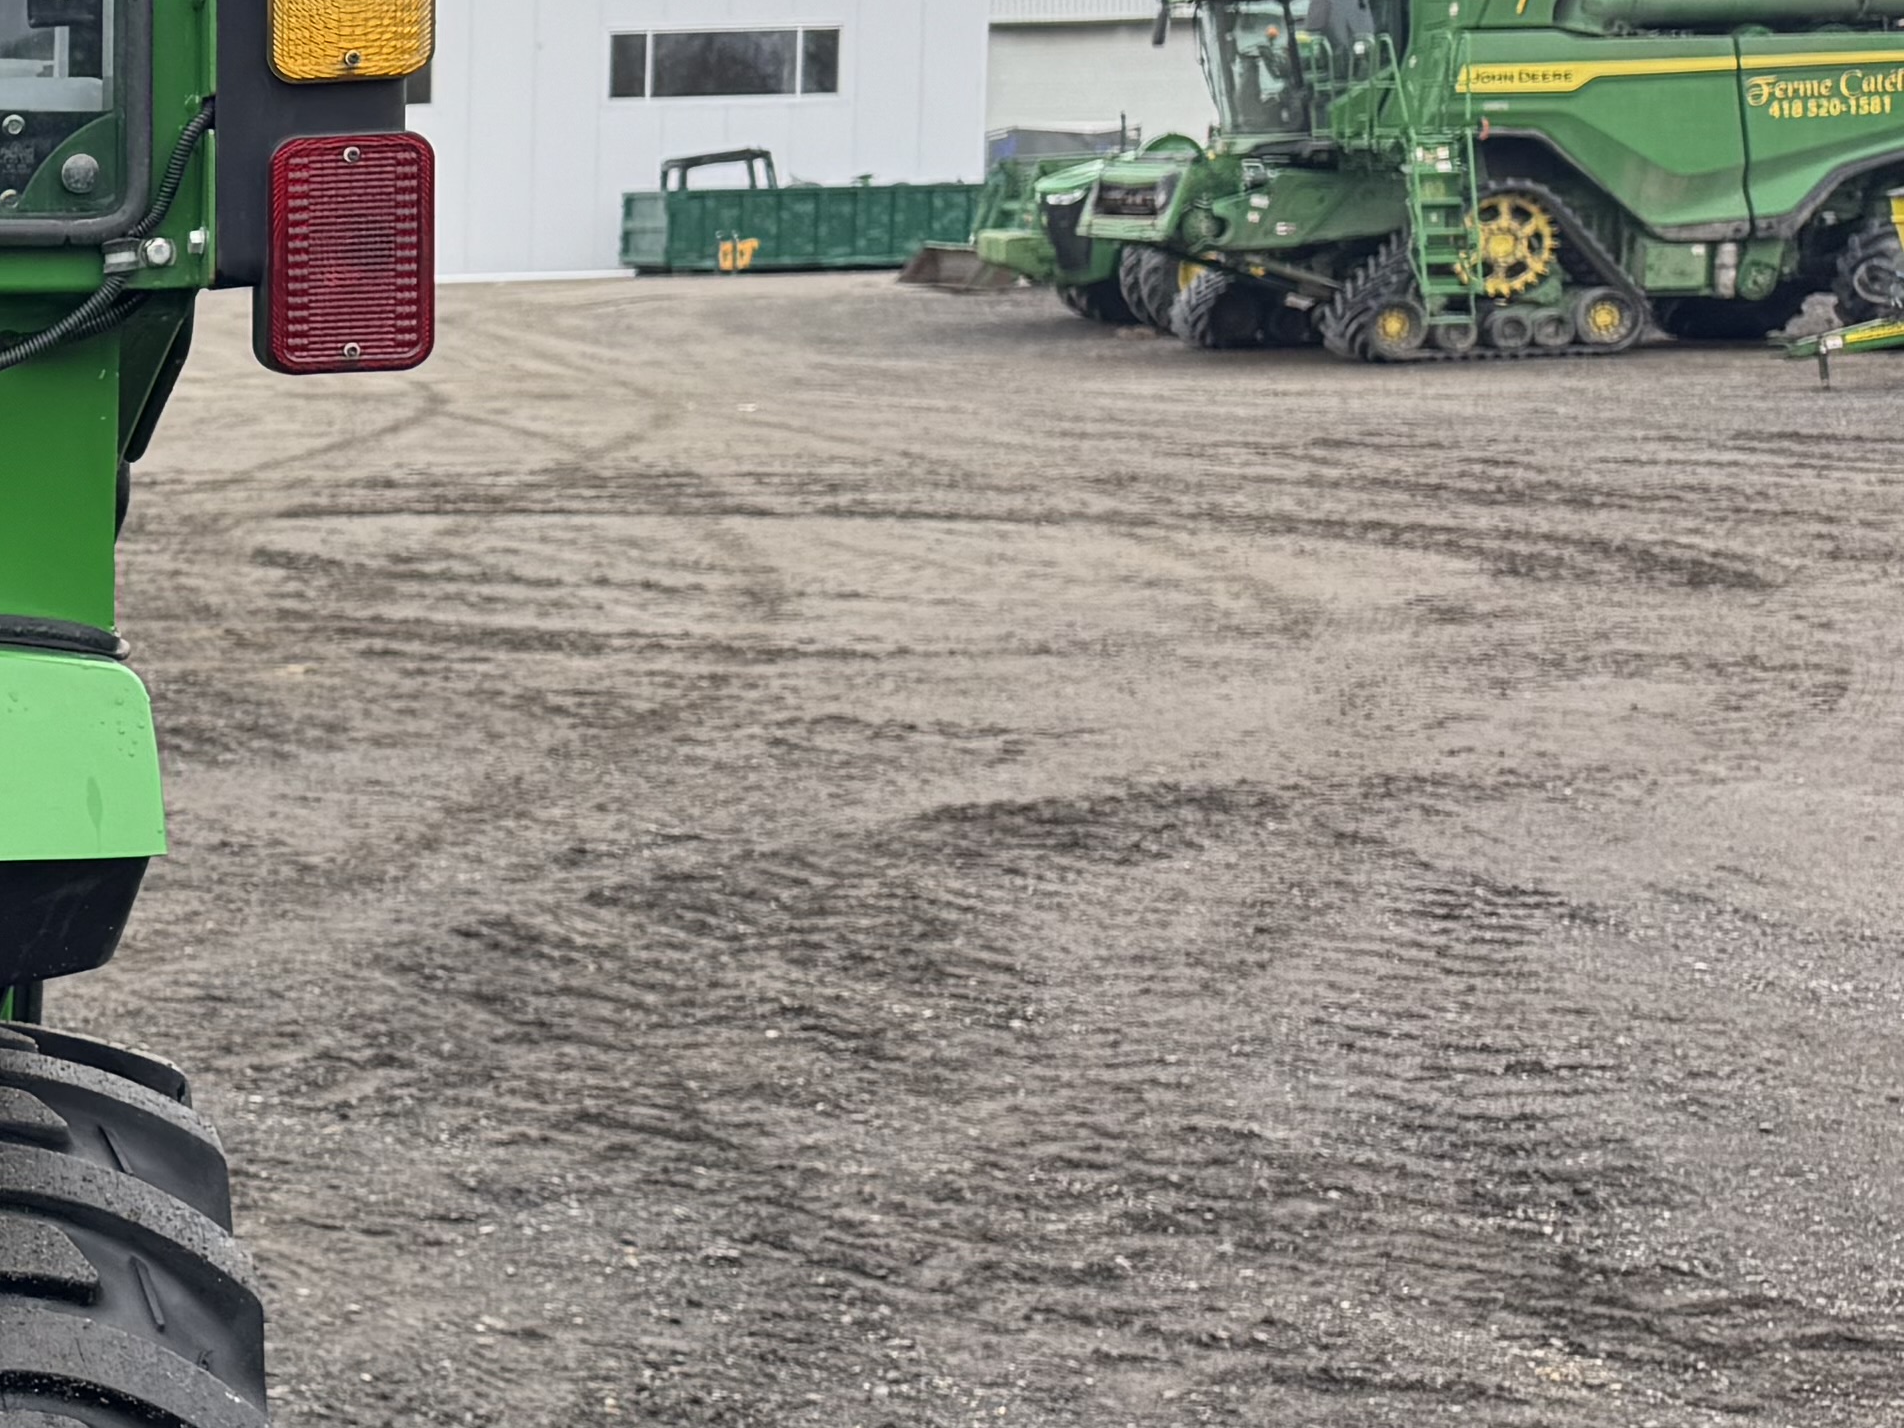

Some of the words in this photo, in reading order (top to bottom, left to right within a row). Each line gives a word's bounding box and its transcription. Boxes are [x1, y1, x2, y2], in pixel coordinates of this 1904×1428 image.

[1470, 68, 1514, 85] JOHN
[1518, 68, 1573, 84] DEERE
[1745, 74, 1833, 107] Ferme
